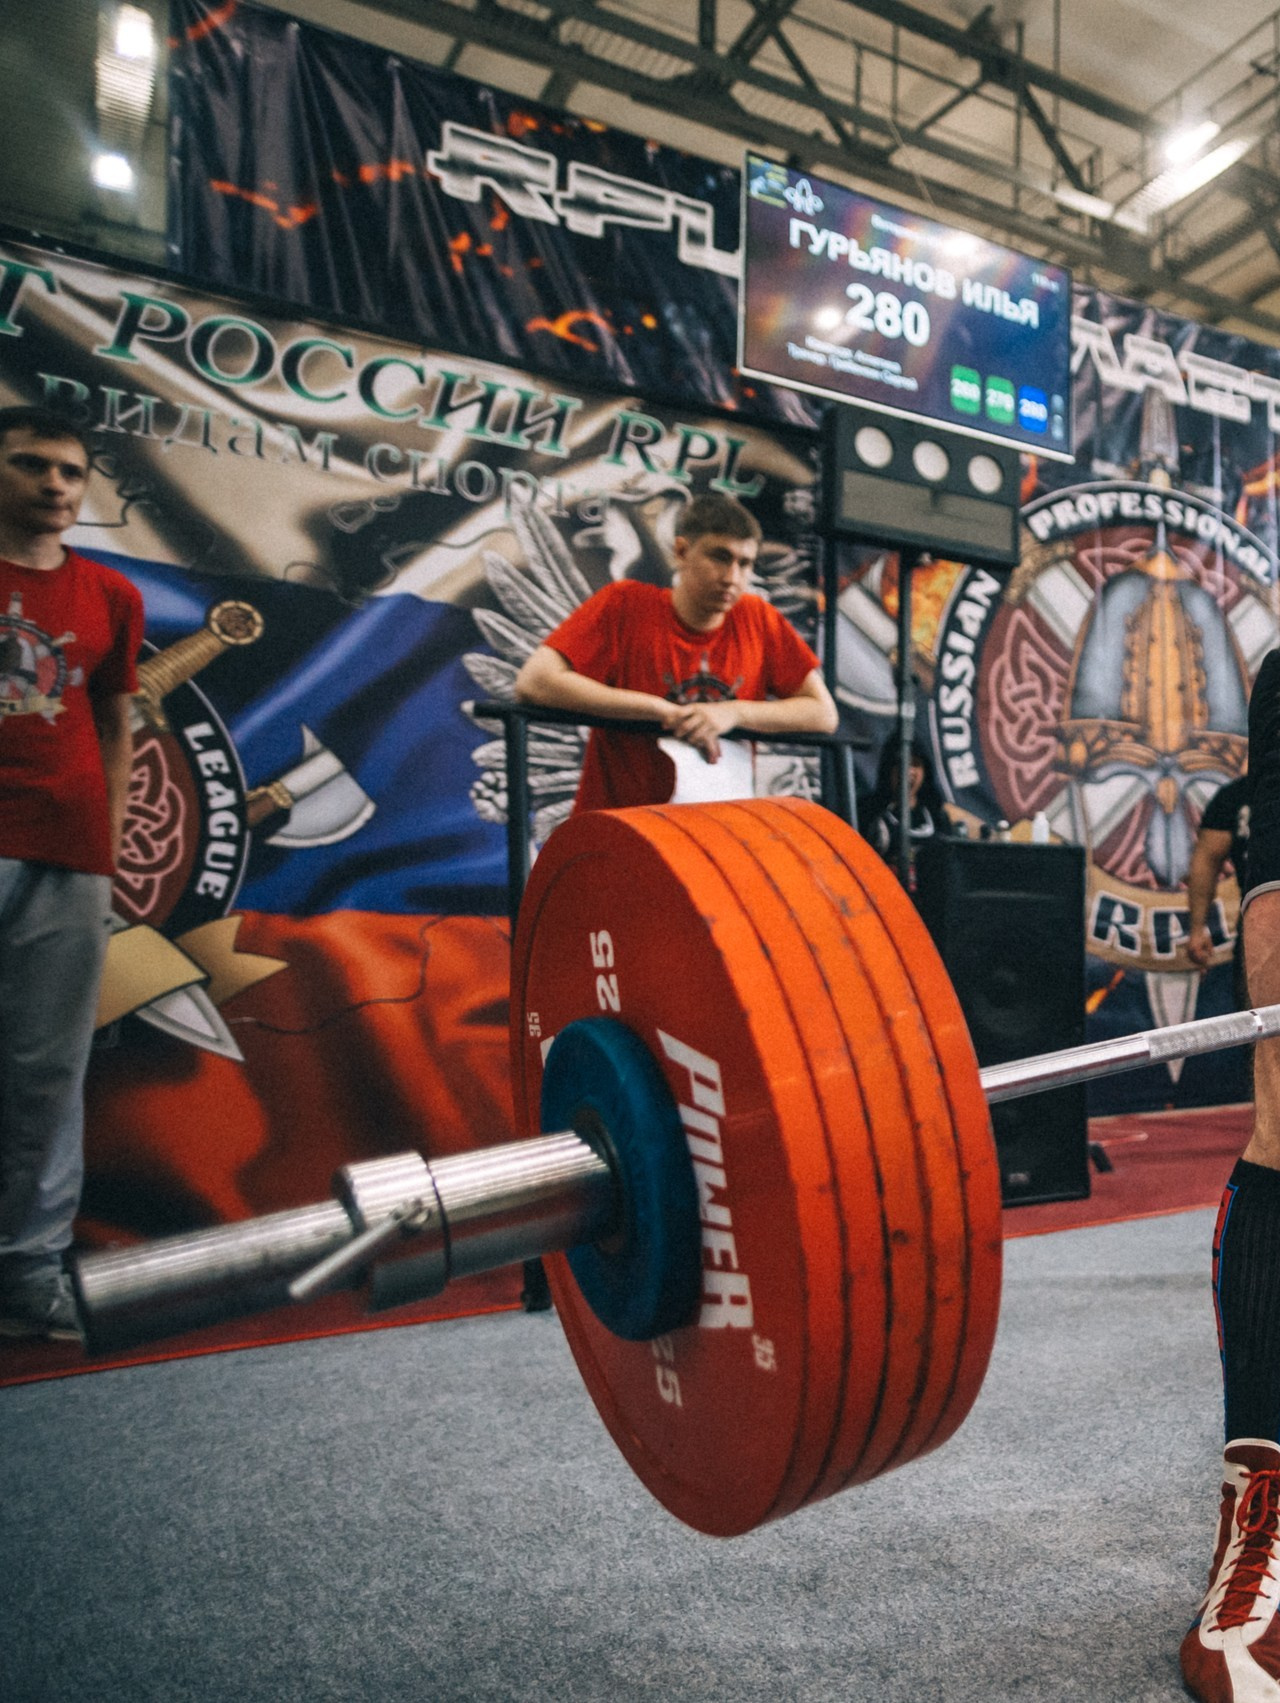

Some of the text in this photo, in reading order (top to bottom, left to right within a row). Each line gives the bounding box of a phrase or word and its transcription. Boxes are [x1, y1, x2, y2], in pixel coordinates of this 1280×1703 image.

[428, 120, 741, 278] RPL
[788, 217, 957, 300] ГУРЬЯНОВ
[962, 278, 1041, 330] ИЛЬЯ
[94, 290, 582, 458] РОССИИ
[605, 409, 766, 497] RPL
[845, 282, 931, 347] 280
[1027, 491, 1275, 588] PROFESSIONAL
[938, 568, 1001, 789] RUSSIAN
[183, 721, 241, 900] LEAGUE
[589, 929, 622, 1013] 25
[656, 1027, 755, 1329] POWER
